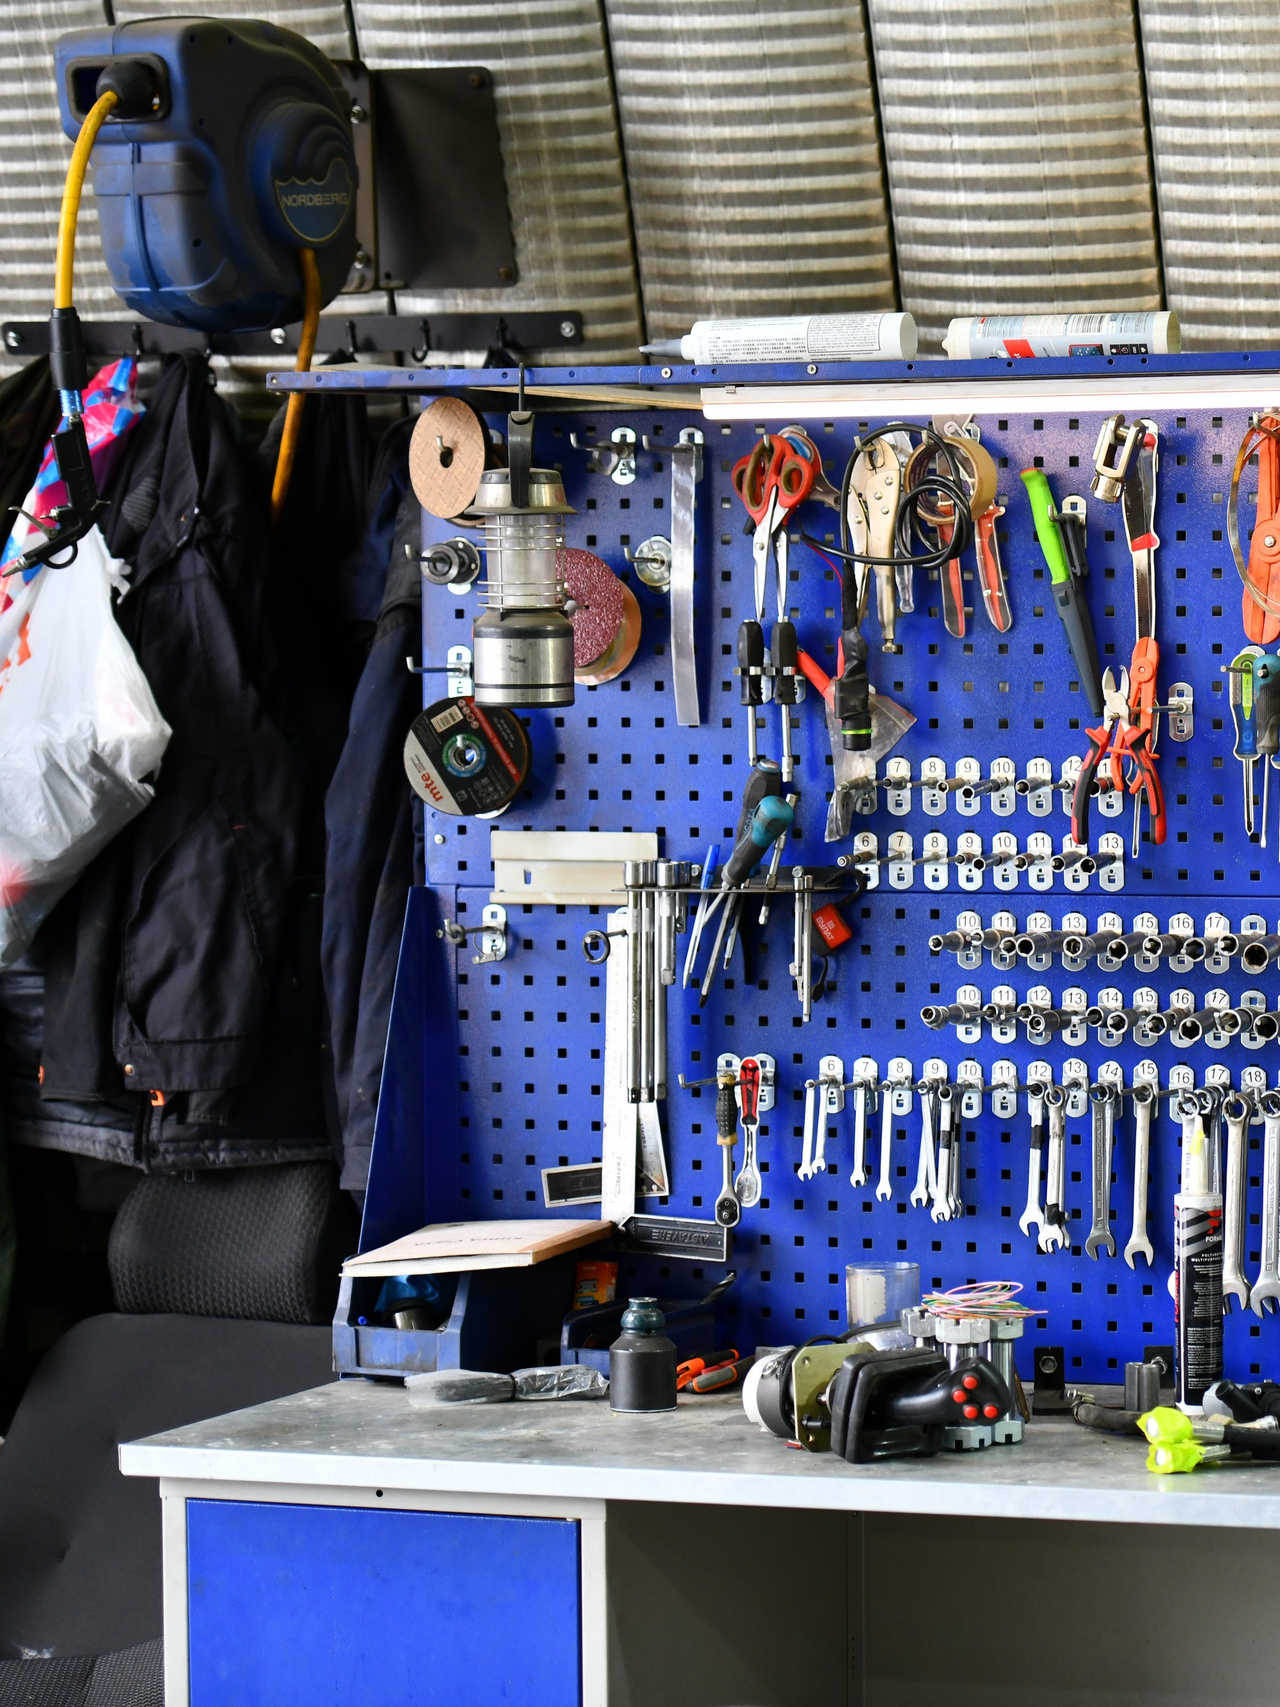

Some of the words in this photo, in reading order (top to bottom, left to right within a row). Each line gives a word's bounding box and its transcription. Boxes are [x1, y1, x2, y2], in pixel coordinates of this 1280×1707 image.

[281, 192, 348, 207] NORDBERG
[894, 762, 900, 771] 7
[929, 762, 936, 772] 8
[964, 762, 971, 772] 9
[998, 762, 1010, 772] 10
[1034, 763, 1044, 773] 11
[1068, 760, 1081, 772] 12
[421, 772, 444, 803] mte
[862, 836, 869, 846] 6
[896, 836, 903, 846] 7
[932, 837, 938, 848] 8
[966, 837, 973, 847] 9
[999, 837, 1011, 847] 10
[1034, 837, 1044, 847] 11
[1105, 837, 1118, 848] 13
[964, 916, 976, 926] 10
[999, 917, 1009, 926] 11
[1034, 918, 1046, 928] 12
[1067, 917, 1080, 928] 13
[1103, 917, 1115, 927] 14
[1141, 917, 1153, 927] 15
[1177, 918, 1189, 928] 16
[1209, 917, 1219, 927] 17
[815, 915, 836, 941] БУЛАТ
[964, 990, 976, 1000] 10
[999, 990, 1009, 999] 11
[1034, 990, 1047, 1000] 12
[1069, 993, 1082, 1004] 13
[1107, 992, 1118, 1002] 14
[1139, 991, 1153, 1002] 15
[1176, 993, 1189, 1004] 16
[1213, 992, 1226, 1003] 17
[828, 1060, 835, 1070] 6
[862, 1062, 868, 1071] 7
[897, 1062, 903, 1073] 8
[932, 1063, 938, 1072] 9
[964, 1065, 977, 1074] 10
[1068, 1062, 1081, 1071] 13
[1106, 1064, 1118, 1075] 14
[1142, 1063, 1154, 1074] 15
[1035, 1065, 1047, 1076] 12
[1213, 1068, 1225, 1079] 17
[1178, 1072, 1189, 1083] 16
[1248, 1071, 1262, 1082] 18
